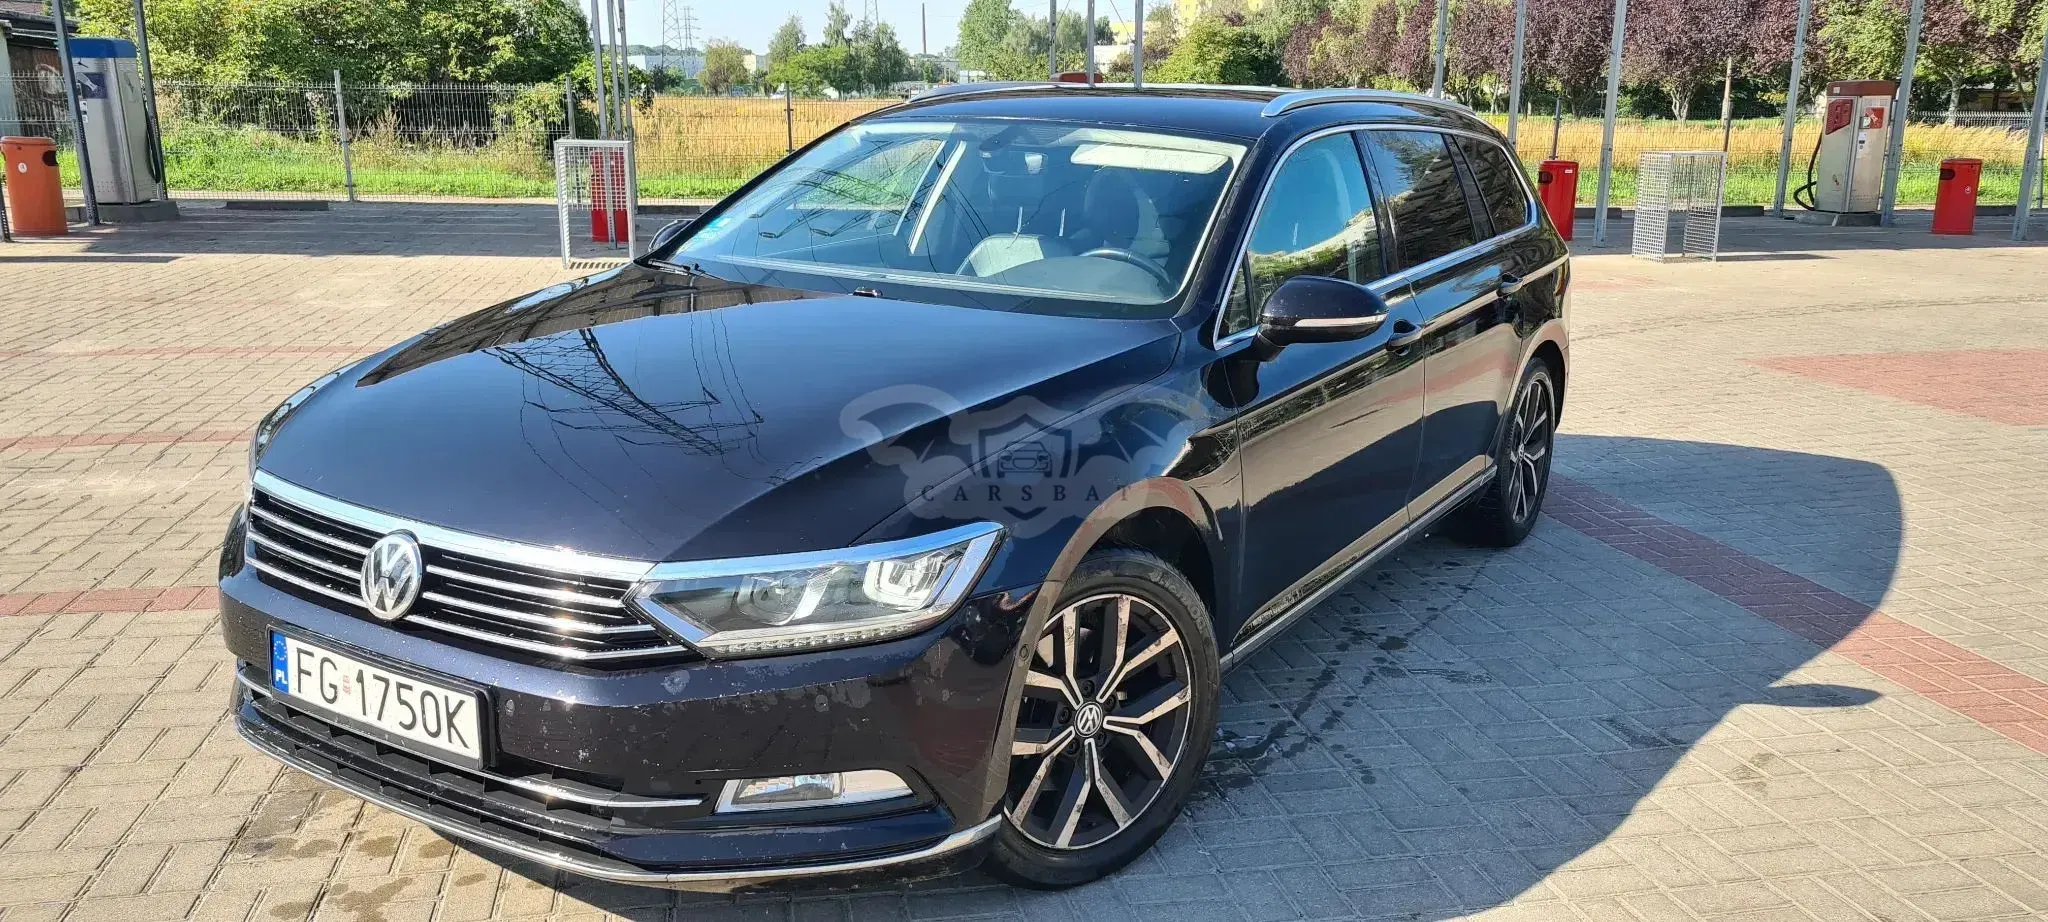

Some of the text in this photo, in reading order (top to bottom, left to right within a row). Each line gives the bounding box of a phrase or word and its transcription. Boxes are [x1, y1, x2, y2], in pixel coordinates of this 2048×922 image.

[363, 536, 418, 617] VW
[275, 668, 288, 685] PL
[297, 647, 470, 749] FG 1750K
